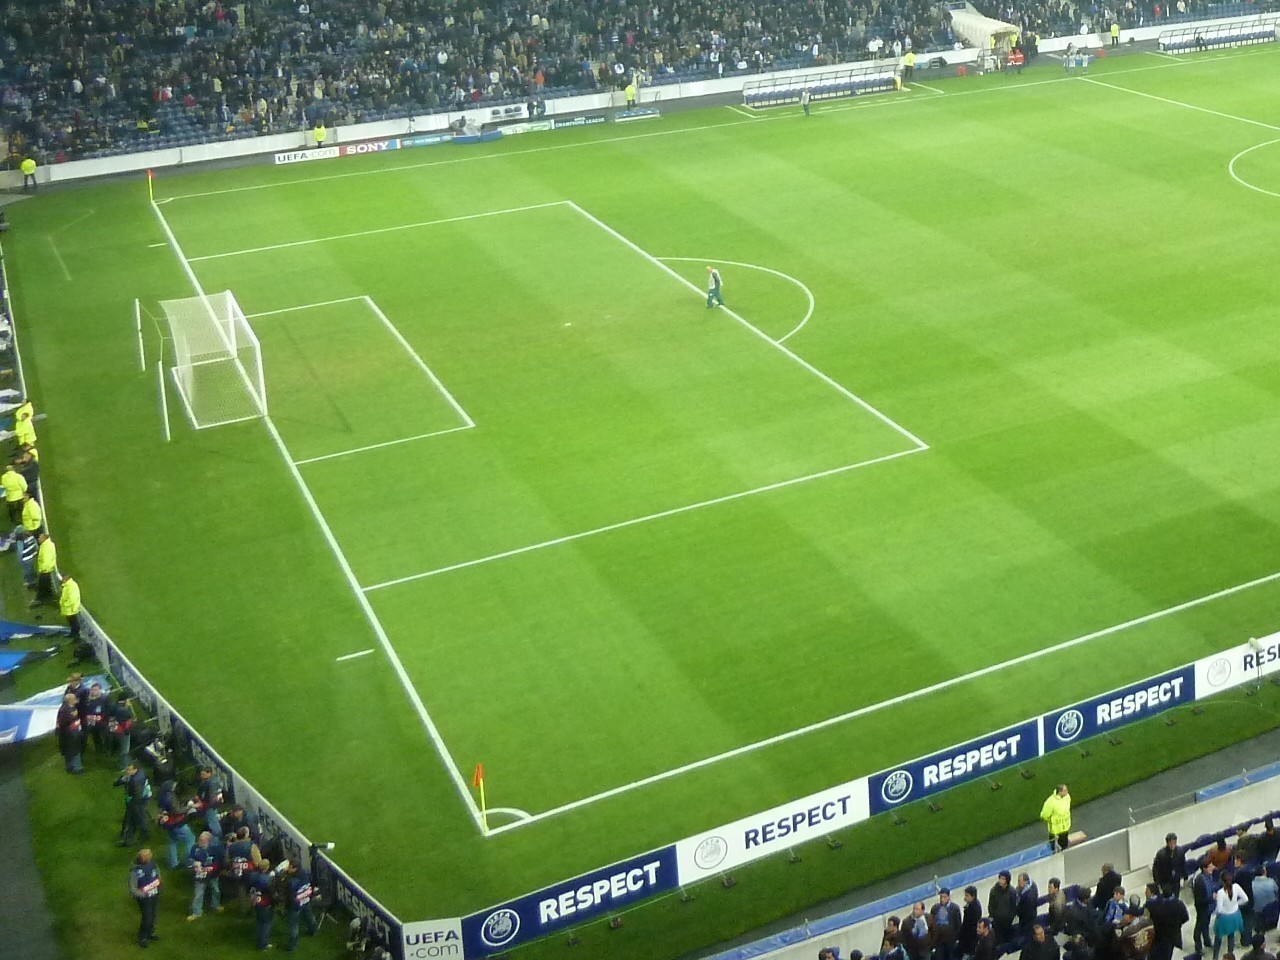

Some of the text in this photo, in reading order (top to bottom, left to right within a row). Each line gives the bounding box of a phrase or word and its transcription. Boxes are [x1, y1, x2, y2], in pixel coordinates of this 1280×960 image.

[346, 141, 389, 155] SONY
[1096, 676, 1184, 726] RESPECT
[923, 734, 1021, 788] RESPECT
[744, 794, 851, 850] RESPECT
[539, 860, 661, 925] RESPECT
[405, 929, 460, 946] UEFA
[410, 942, 459, 959] .com
